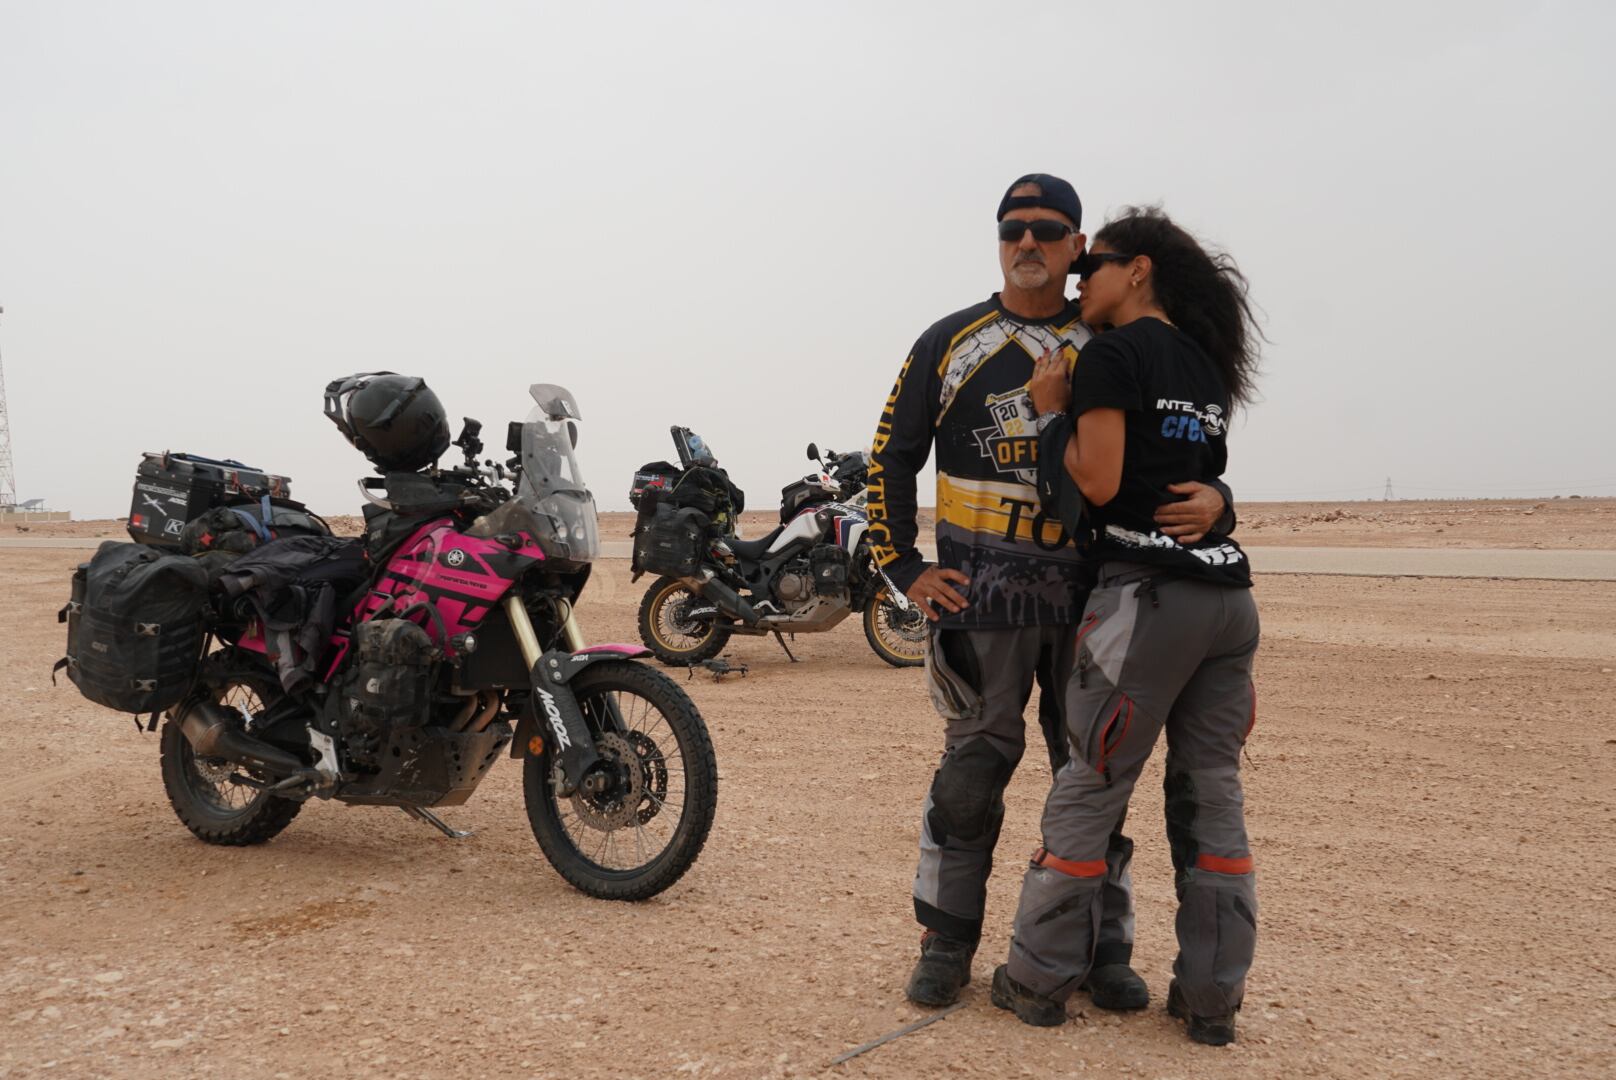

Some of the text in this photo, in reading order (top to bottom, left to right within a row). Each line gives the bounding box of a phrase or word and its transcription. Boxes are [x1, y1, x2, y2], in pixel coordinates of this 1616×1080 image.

[999, 403, 1019, 422] 20
[1004, 418, 1025, 437] 22
[536, 686, 572, 752] MOTOZ
